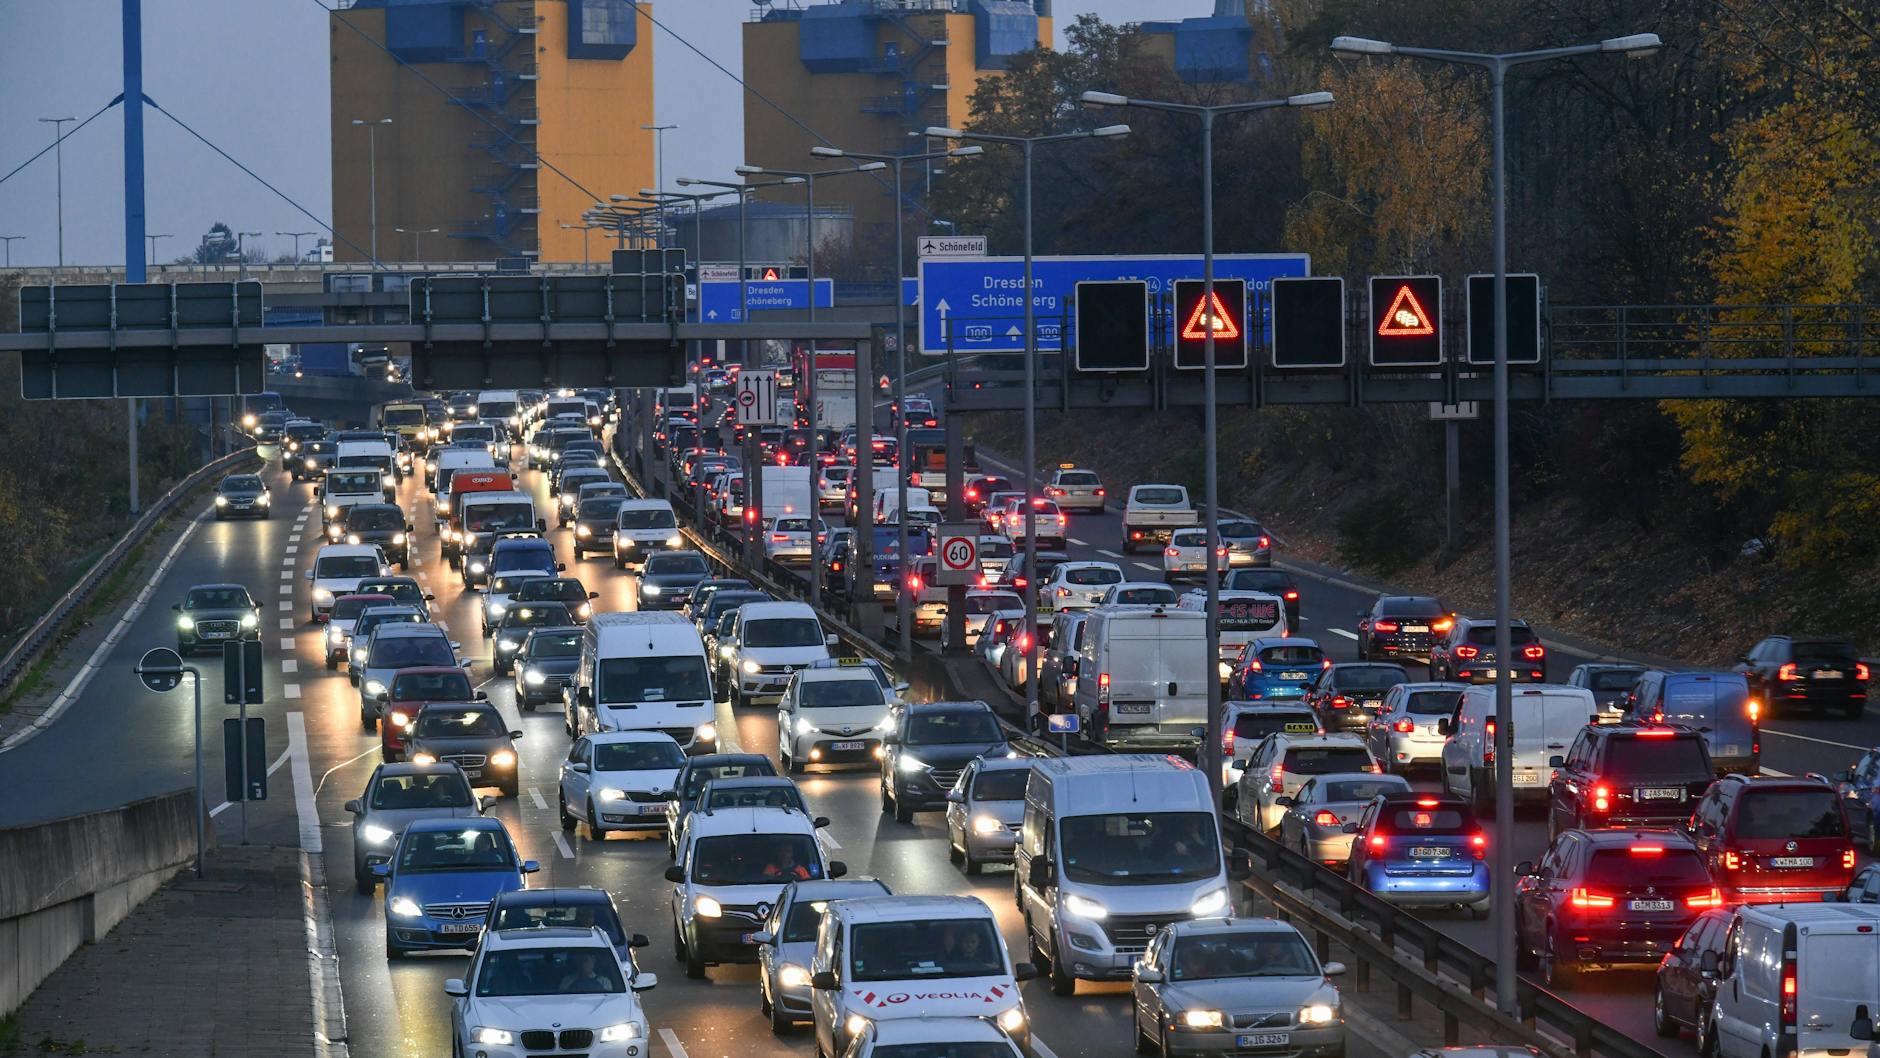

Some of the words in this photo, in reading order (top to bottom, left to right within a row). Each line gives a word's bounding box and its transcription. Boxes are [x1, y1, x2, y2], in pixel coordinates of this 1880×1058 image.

[939, 241, 983, 252] Schönefeld
[984, 276, 1043, 289] Dresden
[746, 296, 792, 306] chöneberg
[972, 294, 1056, 309] Schöneerg
[970, 328, 987, 337] 100
[1040, 328, 1058, 338] 100
[950, 545, 968, 561] 60
[1432, 848, 1450, 856] 7380
[1635, 901, 1640, 909] B
[464, 924, 478, 932] 655
[1243, 1035, 1248, 1045] B
[1266, 1034, 1287, 1044] 3267
